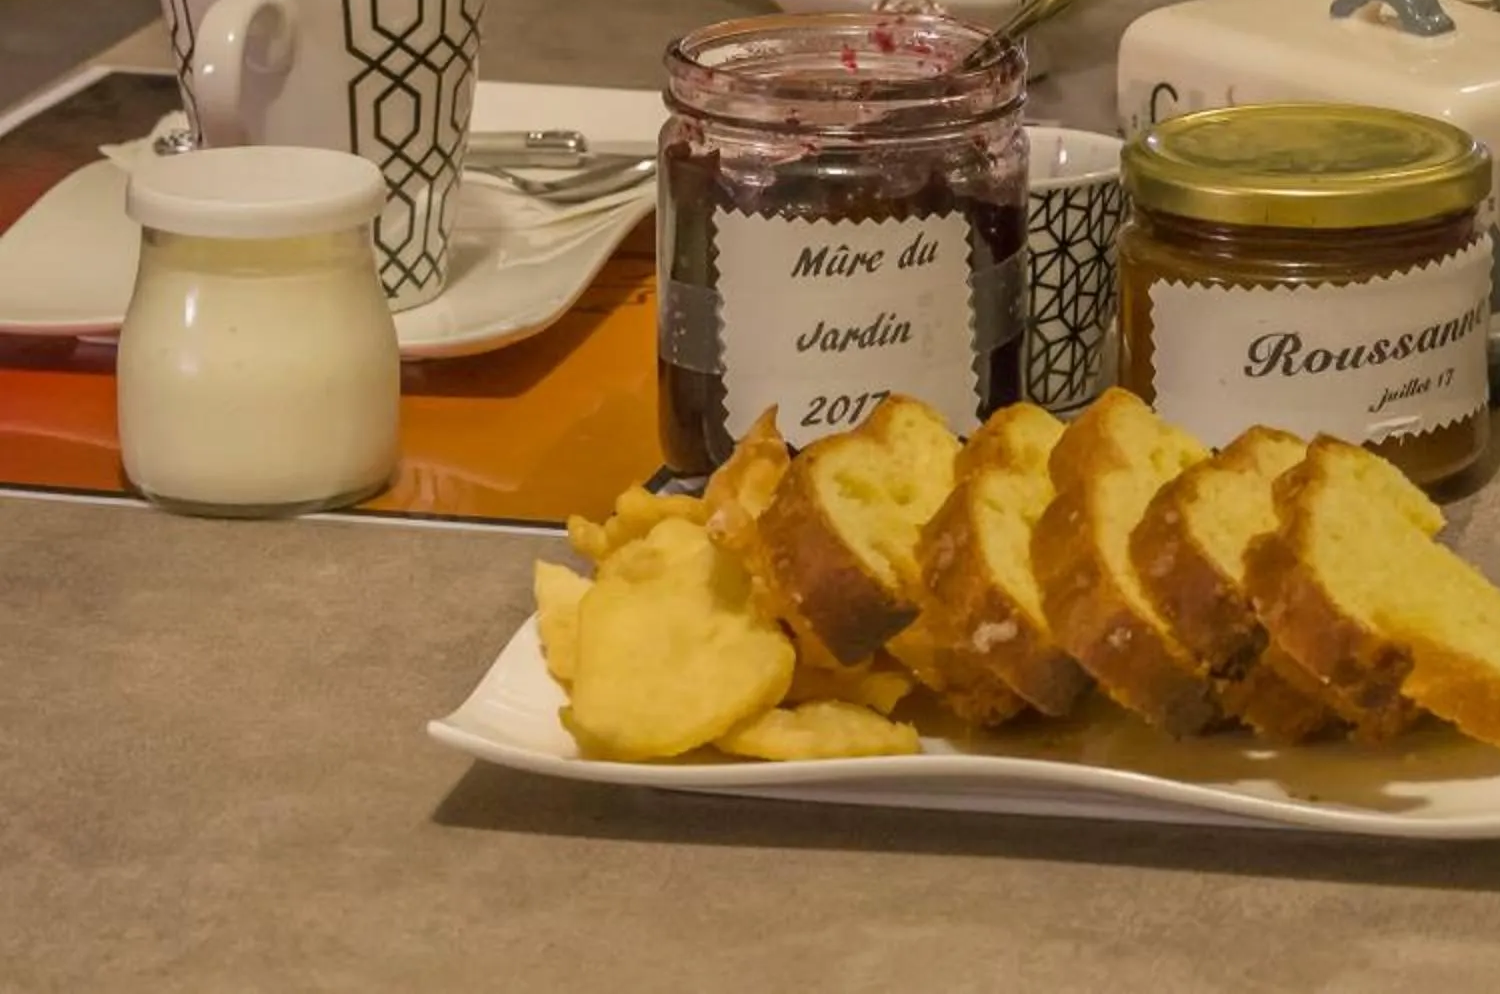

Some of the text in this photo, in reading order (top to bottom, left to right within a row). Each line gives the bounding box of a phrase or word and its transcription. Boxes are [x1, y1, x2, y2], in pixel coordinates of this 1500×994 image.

[790, 231, 939, 278] Mûre du
[796, 312, 913, 353] Jardin
[1367, 376, 1432, 413] juillet
